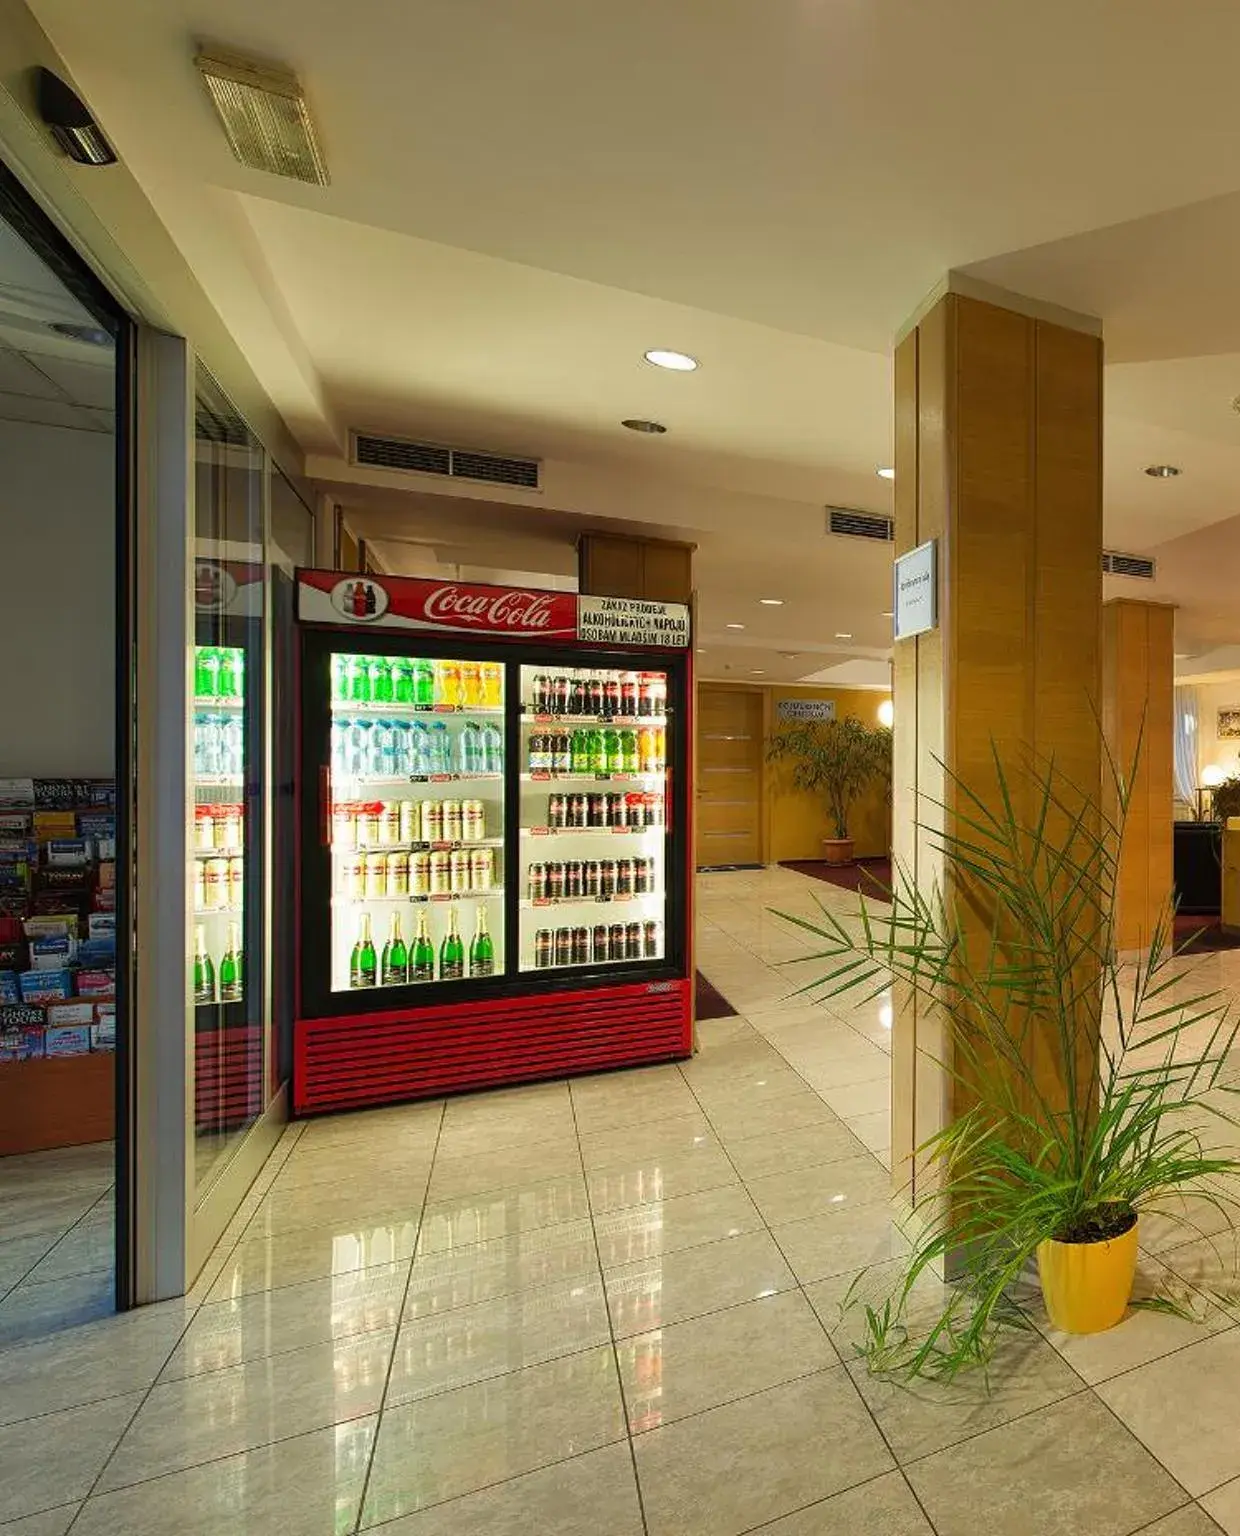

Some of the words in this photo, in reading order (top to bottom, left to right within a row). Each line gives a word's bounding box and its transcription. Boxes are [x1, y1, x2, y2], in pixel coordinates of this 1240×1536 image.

[424, 586, 556, 627] Coca-Cola
[661, 634, 670, 645] 18
[673, 635, 685, 646] LET
